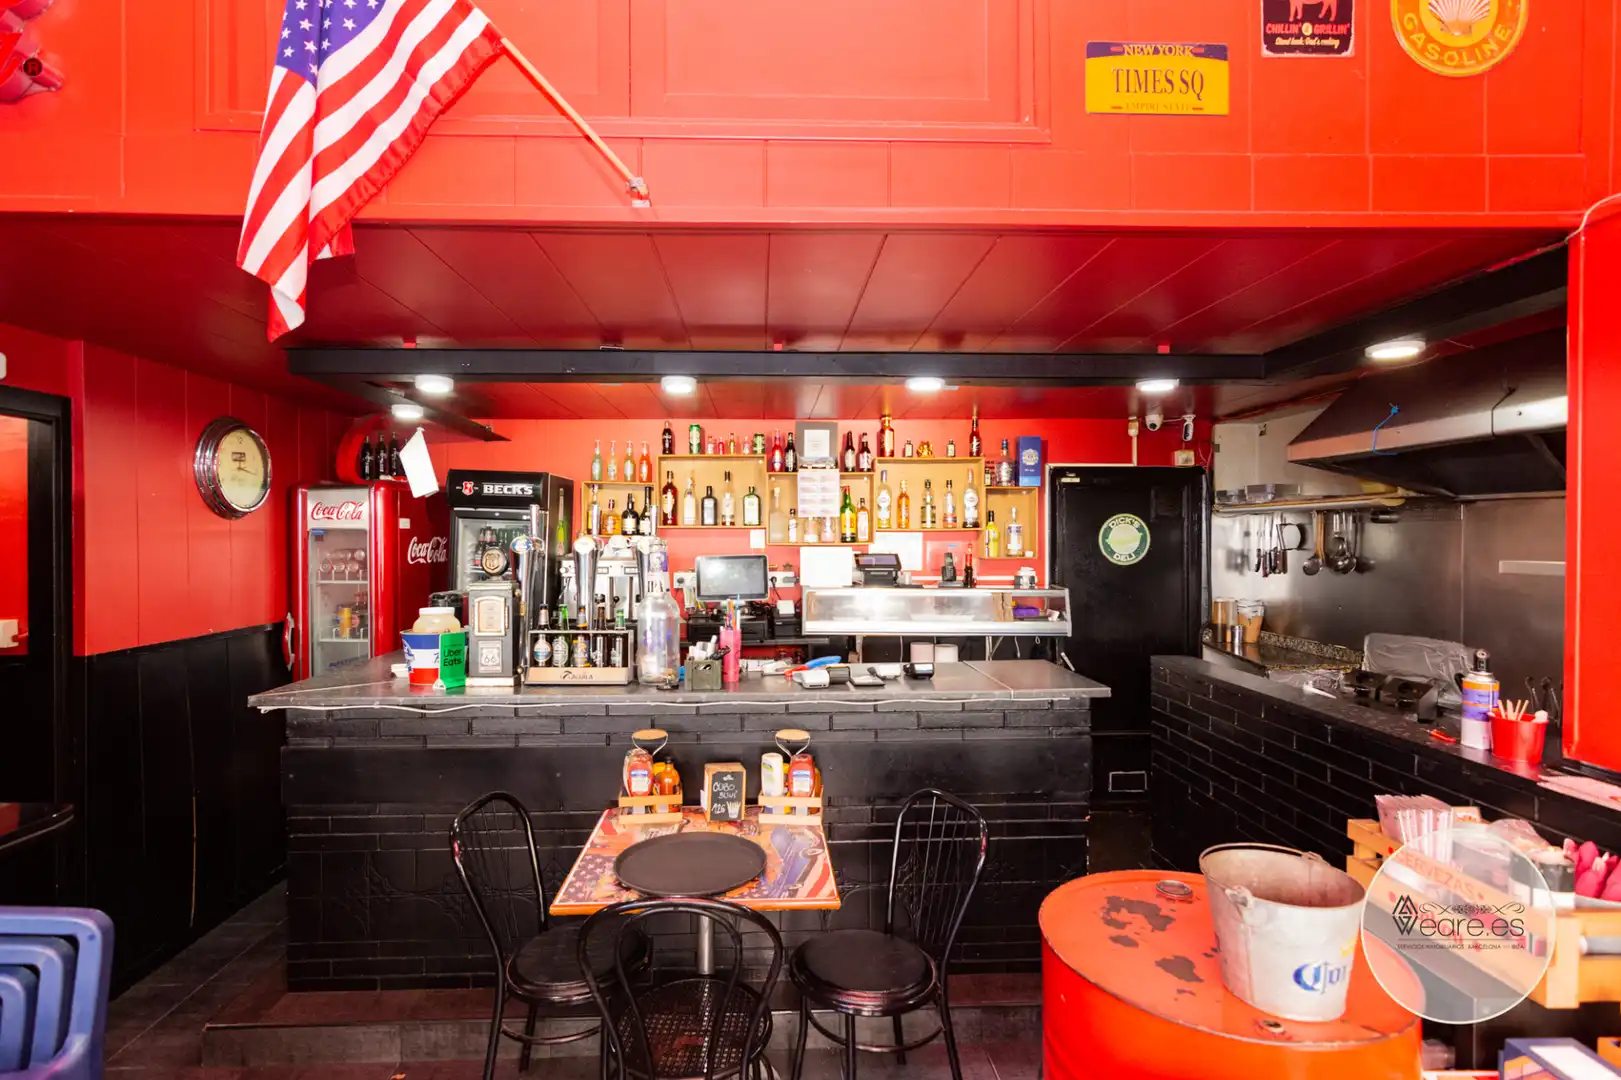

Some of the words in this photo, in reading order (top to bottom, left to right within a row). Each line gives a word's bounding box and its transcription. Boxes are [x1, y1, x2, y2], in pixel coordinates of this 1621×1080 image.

[1266, 22, 1302, 34] CHILLIN'
[1314, 23, 1350, 34] GRILLIN'
[1403, 13, 1513, 66] GASOLINE
[1122, 44, 1156, 56] NEW
[1155, 44, 1195, 57] YORK
[1112, 67, 1174, 94] TIMES
[1179, 68, 1204, 101] SQ
[482, 484, 533, 495] BECK'S
[443, 648, 462, 658] Uber
[443, 657, 462, 667] Eats
